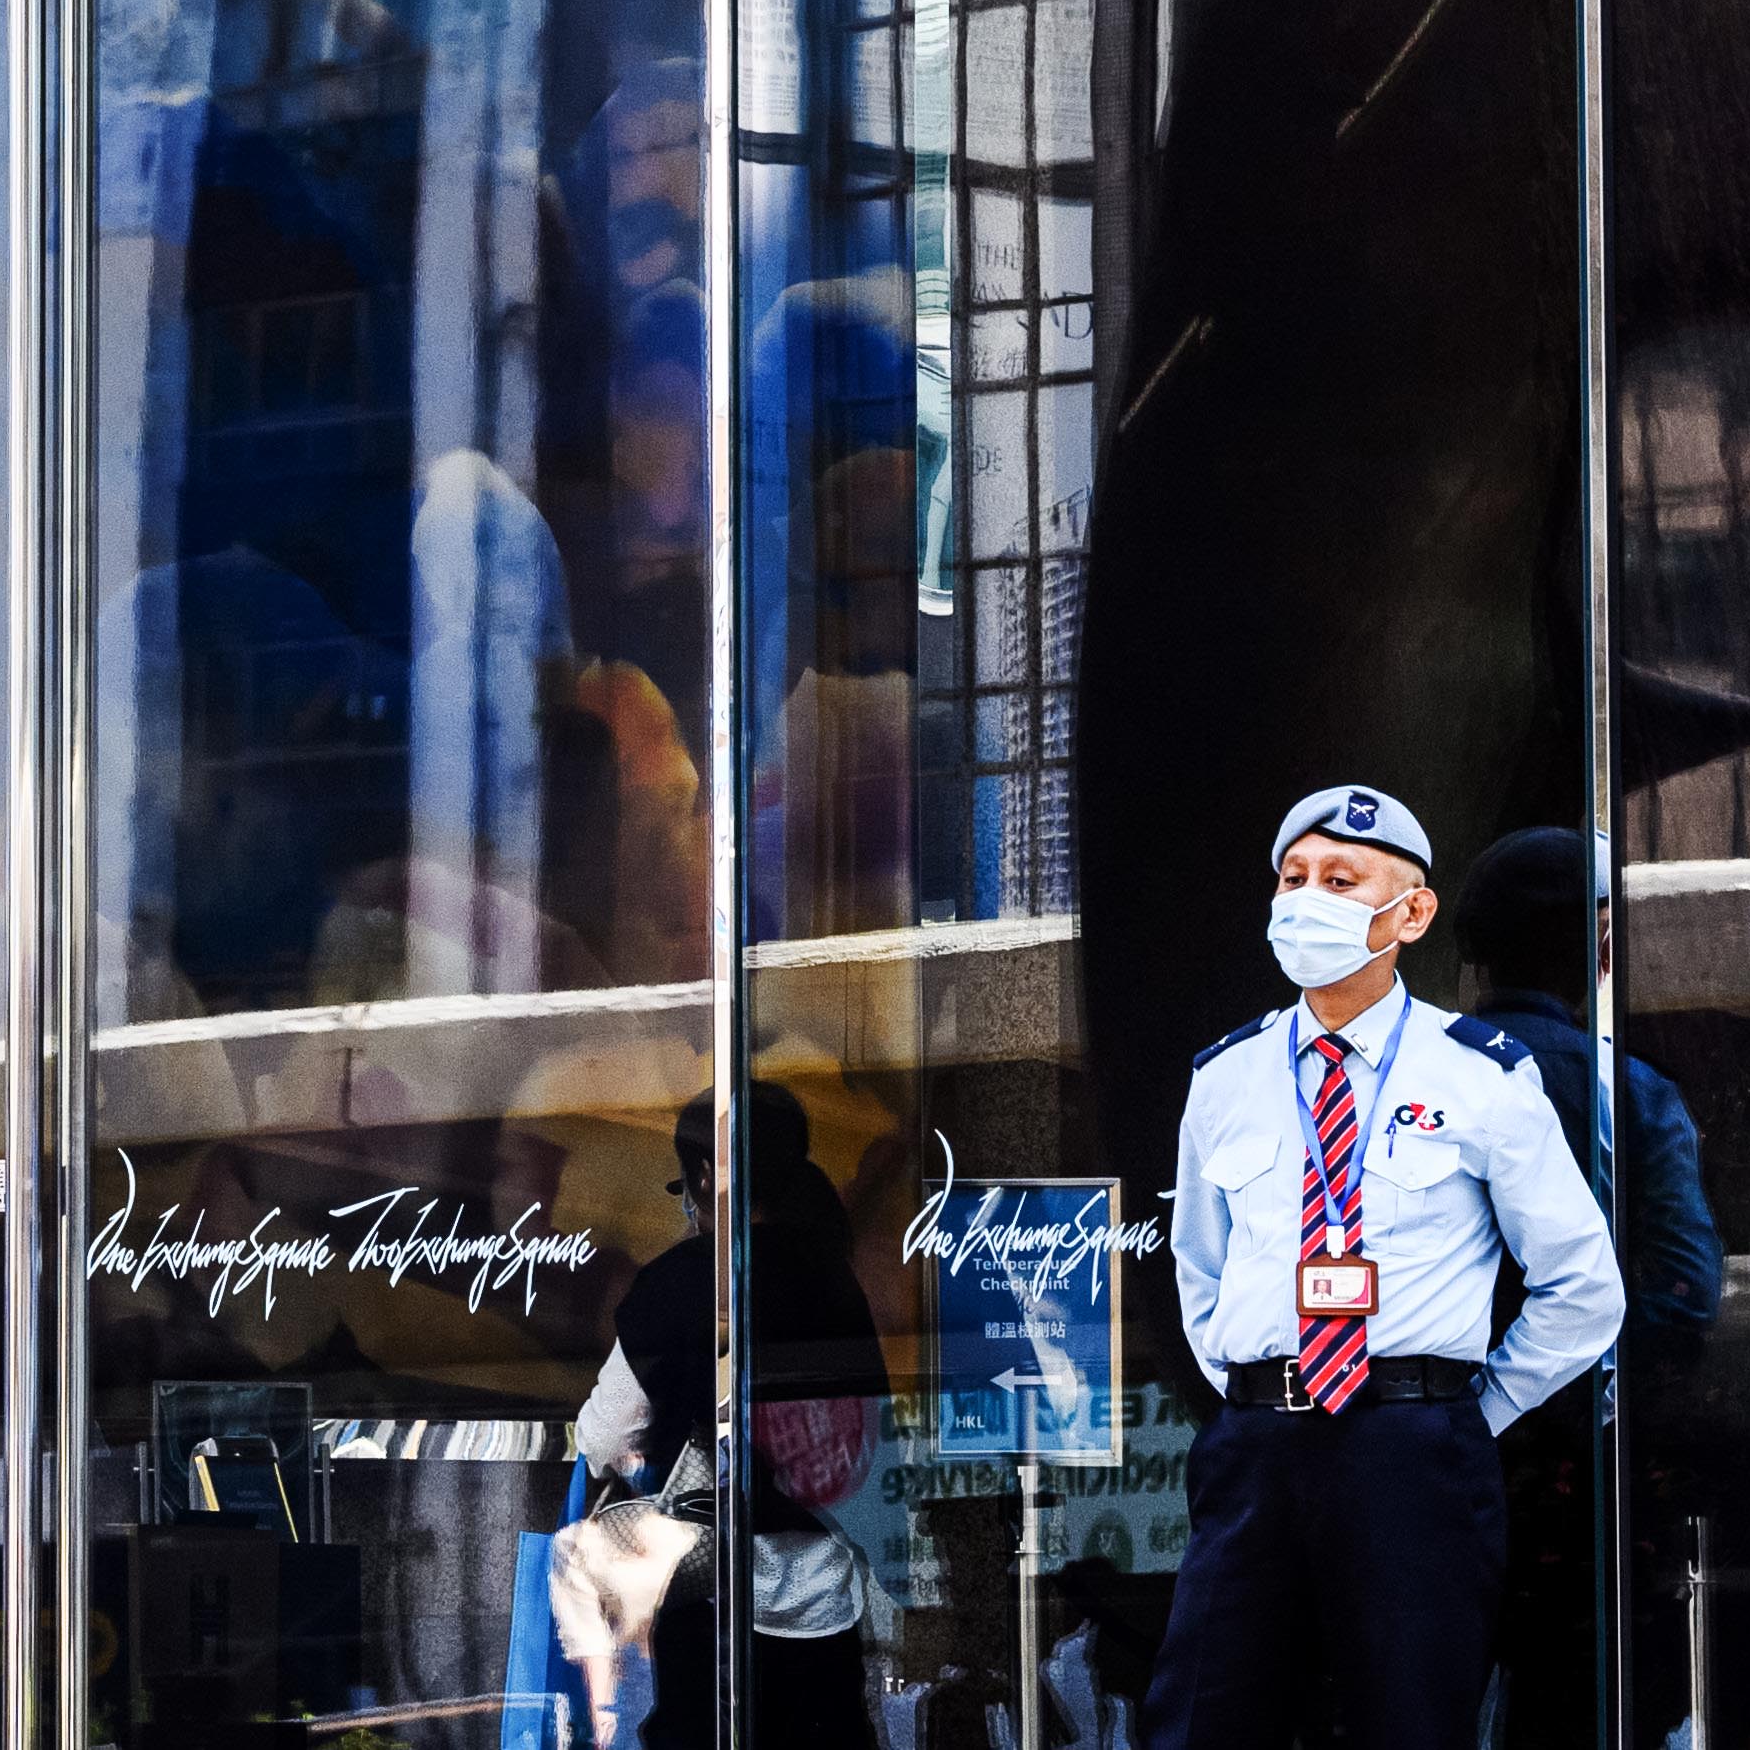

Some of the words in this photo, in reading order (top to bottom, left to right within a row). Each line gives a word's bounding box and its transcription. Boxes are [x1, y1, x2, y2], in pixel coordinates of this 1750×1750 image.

[1395, 1102, 1445, 1131] G4S
[903, 1128, 956, 1264] One
[950, 1186, 1072, 1303] Exchange
[1057, 1189, 1164, 1305] Square
[87, 1148, 138, 1279] One
[132, 1203, 250, 1317] Exchange
[233, 1207, 335, 1320] Square
[328, 1187, 420, 1273] Two
[390, 1198, 511, 1313] Exchange
[493, 1202, 597, 1316] Square
[973, 1257, 1076, 1273] Temperaur
[955, 1415, 986, 1429] HKL
